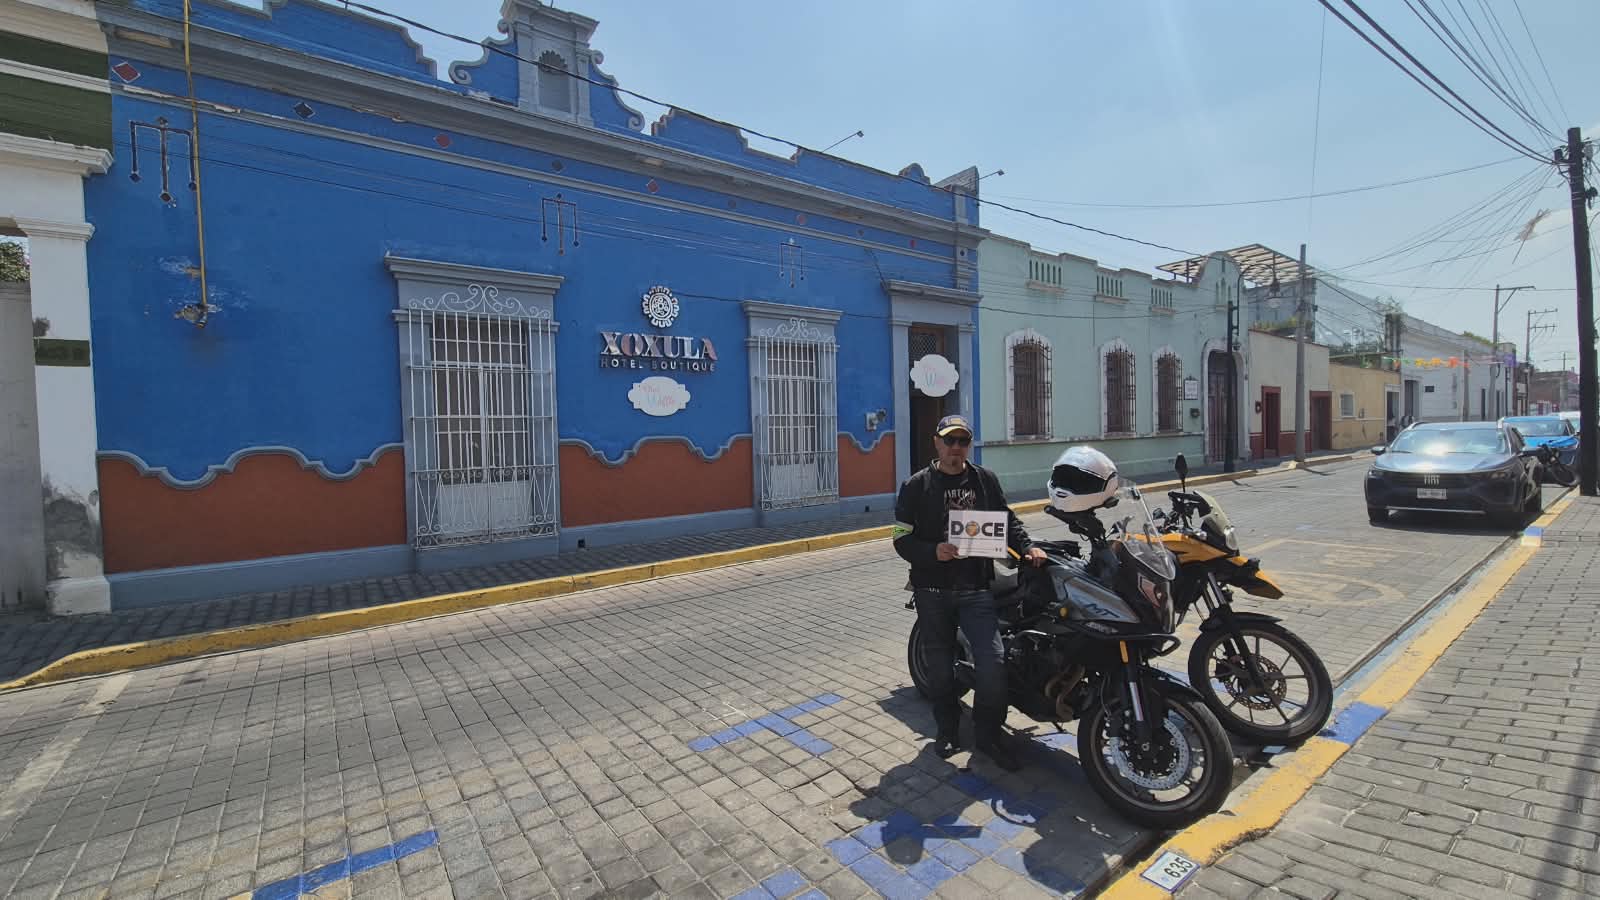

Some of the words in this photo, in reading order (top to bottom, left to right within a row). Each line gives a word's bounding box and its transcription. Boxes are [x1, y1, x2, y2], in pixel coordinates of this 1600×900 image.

[600, 332, 718, 360] XOXULA
[600, 359, 644, 369] HOTEL
[651, 360, 716, 372] BOUTIQUE
[950, 521, 1005, 537] DOCE
[1084, 603, 1121, 619] MT
[1164, 857, 1193, 878] 635
